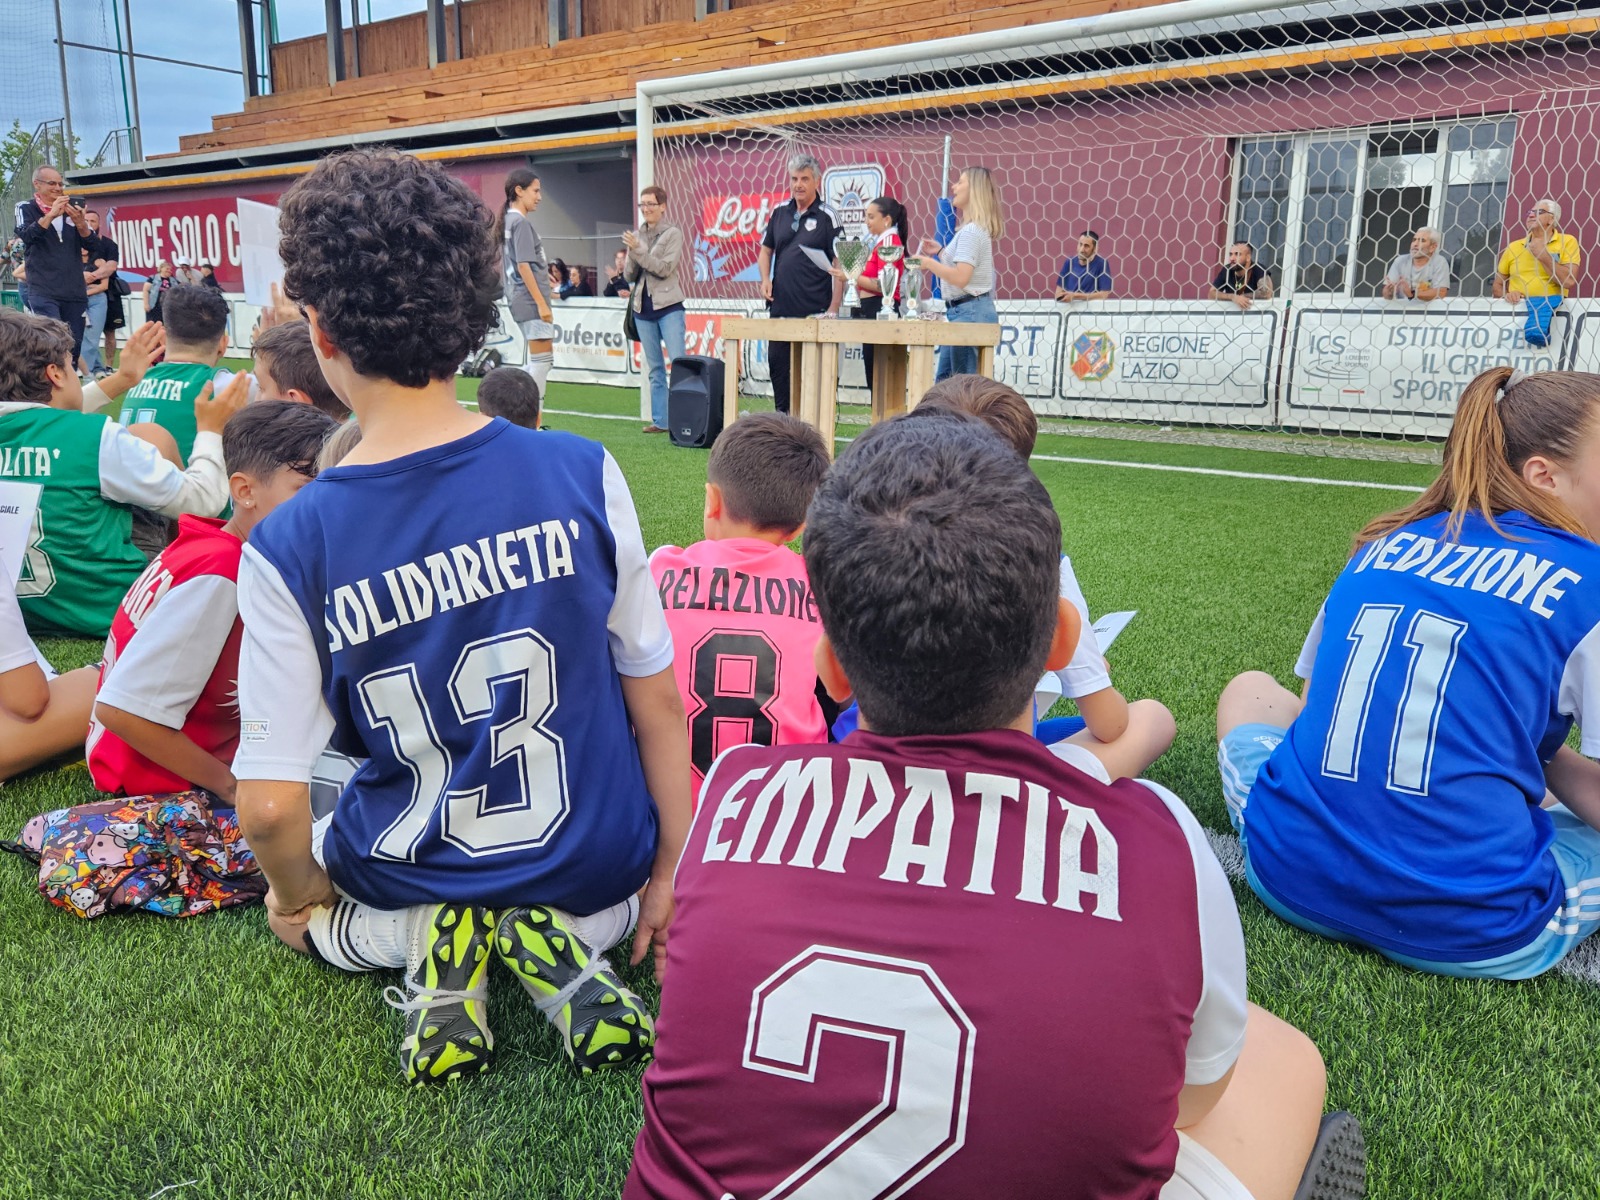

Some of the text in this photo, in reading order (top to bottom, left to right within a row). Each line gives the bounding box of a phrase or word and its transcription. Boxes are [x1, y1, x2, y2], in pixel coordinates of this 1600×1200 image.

[109, 217, 165, 269] VINCE
[168, 213, 221, 268] SOLO
[553, 322, 623, 348] Duferco
[1123, 336, 1211, 354] REGIONE
[1309, 334, 1346, 355] ICS
[1387, 326, 1490, 348] ISTITUTO
[1121, 361, 1180, 380] LAZIO
[1421, 353, 1440, 374] IL
[658, 565, 819, 623] RELAZIONE
[687, 627, 782, 781] 8
[1320, 602, 1469, 797] 11
[356, 627, 571, 864] 13
[701, 756, 1123, 922] EMPATIA
[721, 943, 978, 1200] 2
